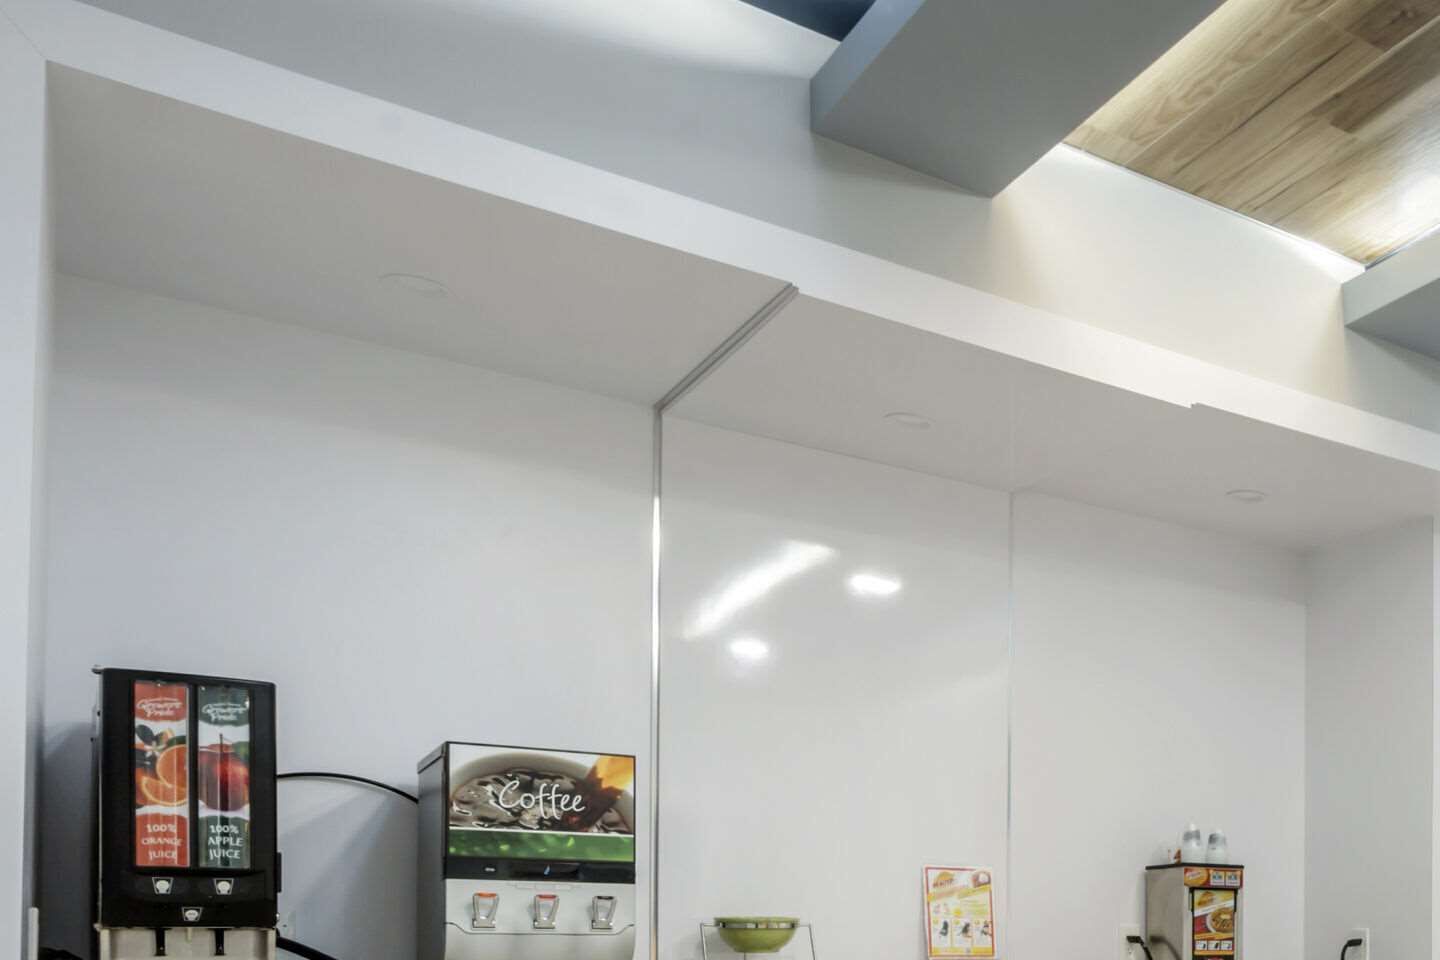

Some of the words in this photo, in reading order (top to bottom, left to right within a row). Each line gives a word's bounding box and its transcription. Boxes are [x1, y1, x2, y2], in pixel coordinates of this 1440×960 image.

[499, 780, 586, 820] Coffee
[146, 823, 177, 833] 100%
[209, 825, 239, 834] 100%
[141, 838, 182, 847] ORANGE
[208, 837, 244, 847] APPLE
[148, 849, 178, 861] JUICE
[209, 849, 240, 860] JUICE
